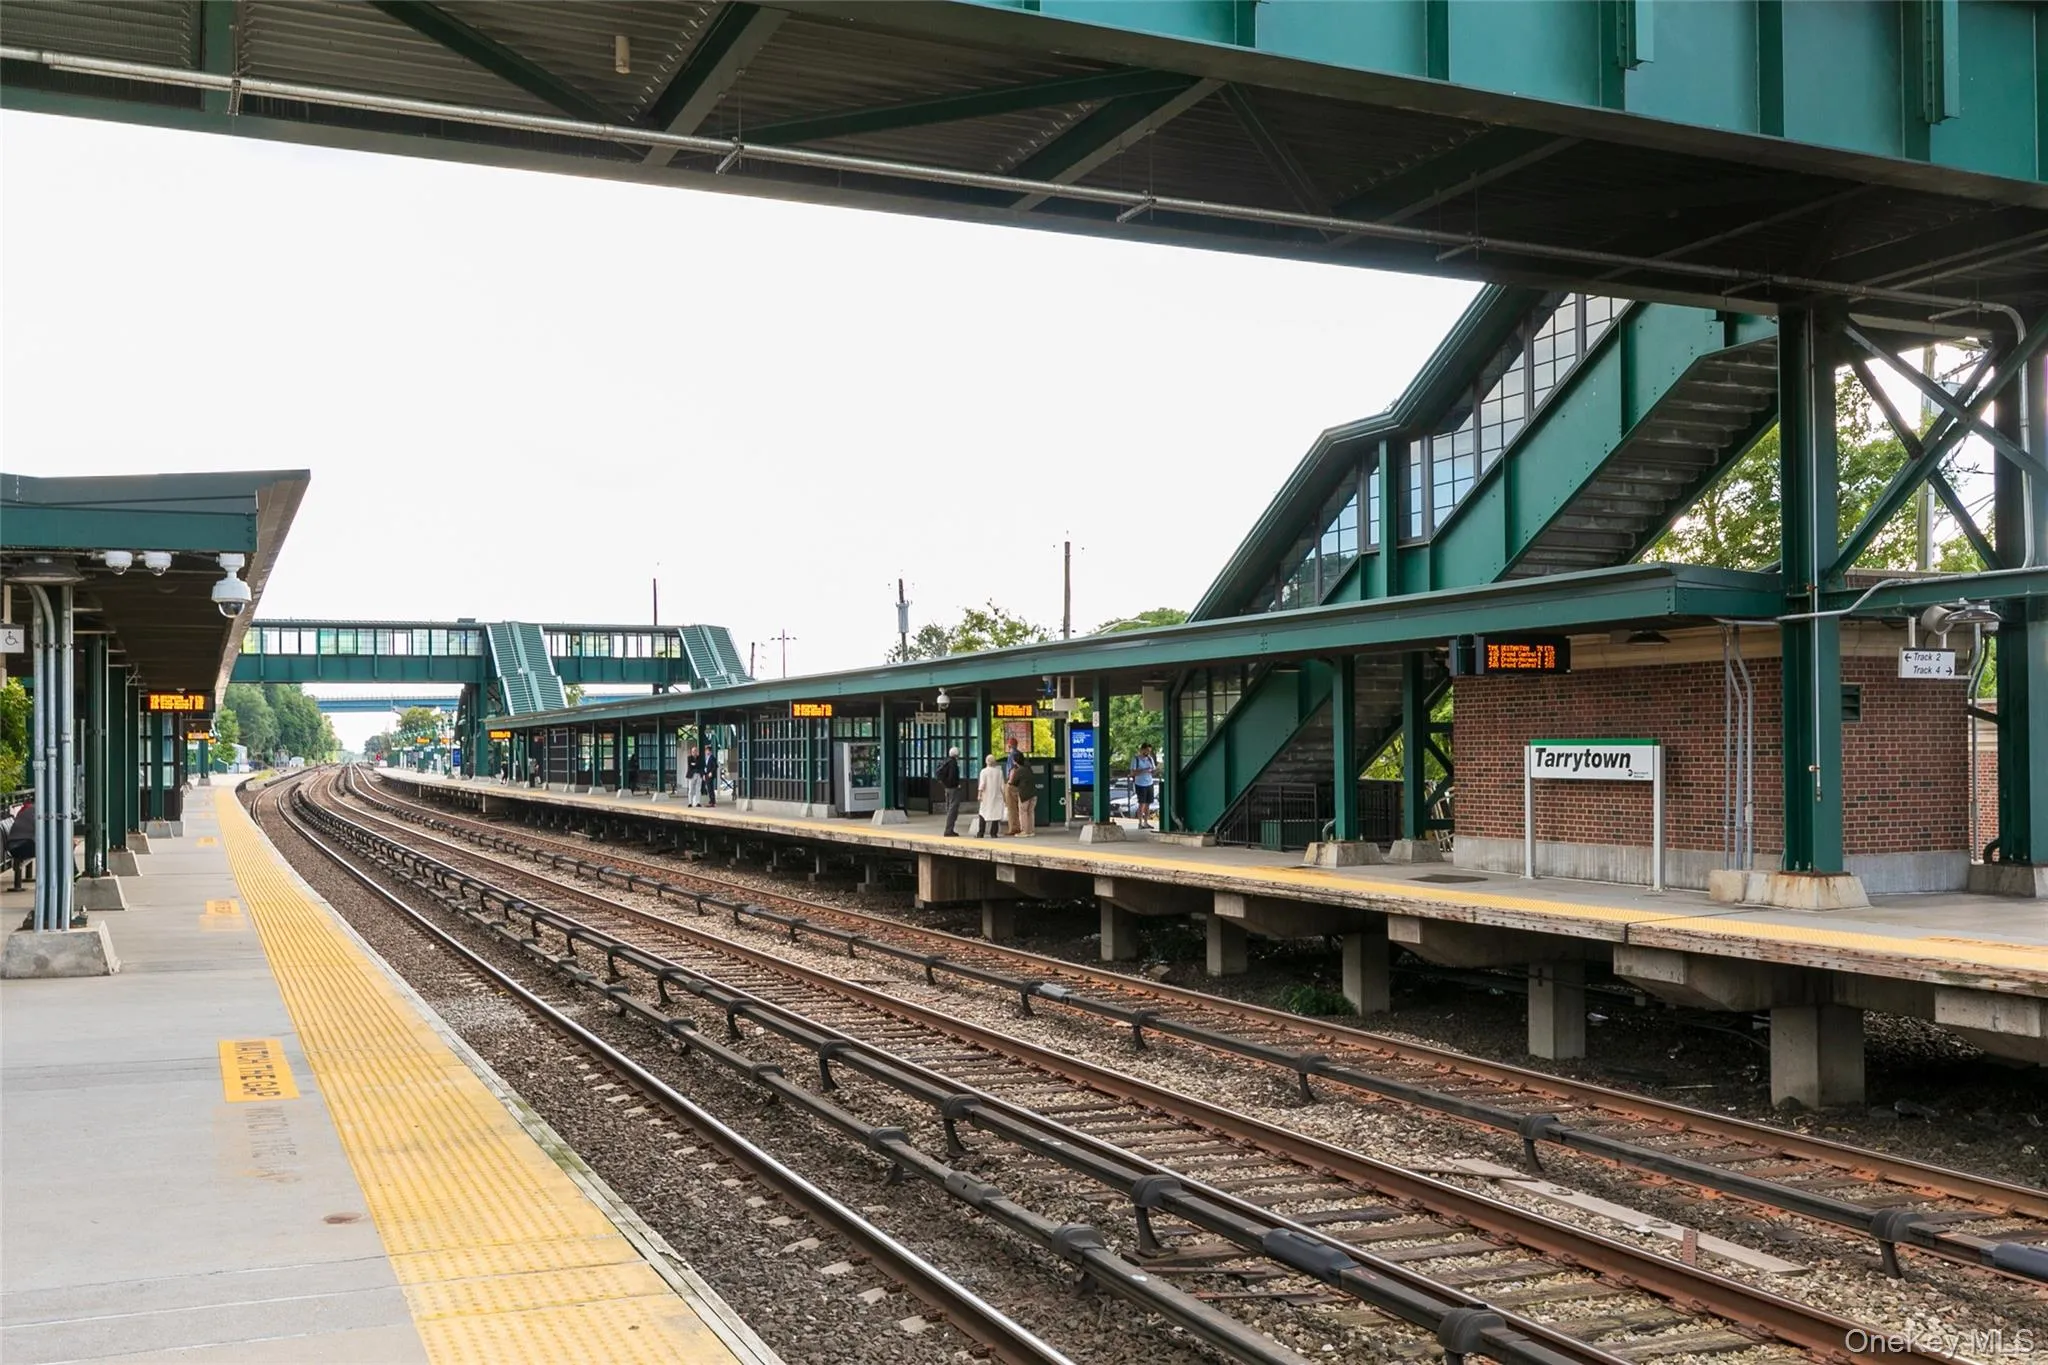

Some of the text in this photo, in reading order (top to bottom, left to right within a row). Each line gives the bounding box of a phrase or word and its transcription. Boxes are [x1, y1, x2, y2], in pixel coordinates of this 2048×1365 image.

[1913, 652, 1942, 662] Track 2
[1913, 665, 1941, 675] Track 4
[1534, 747, 1632, 772] Tarrytown
